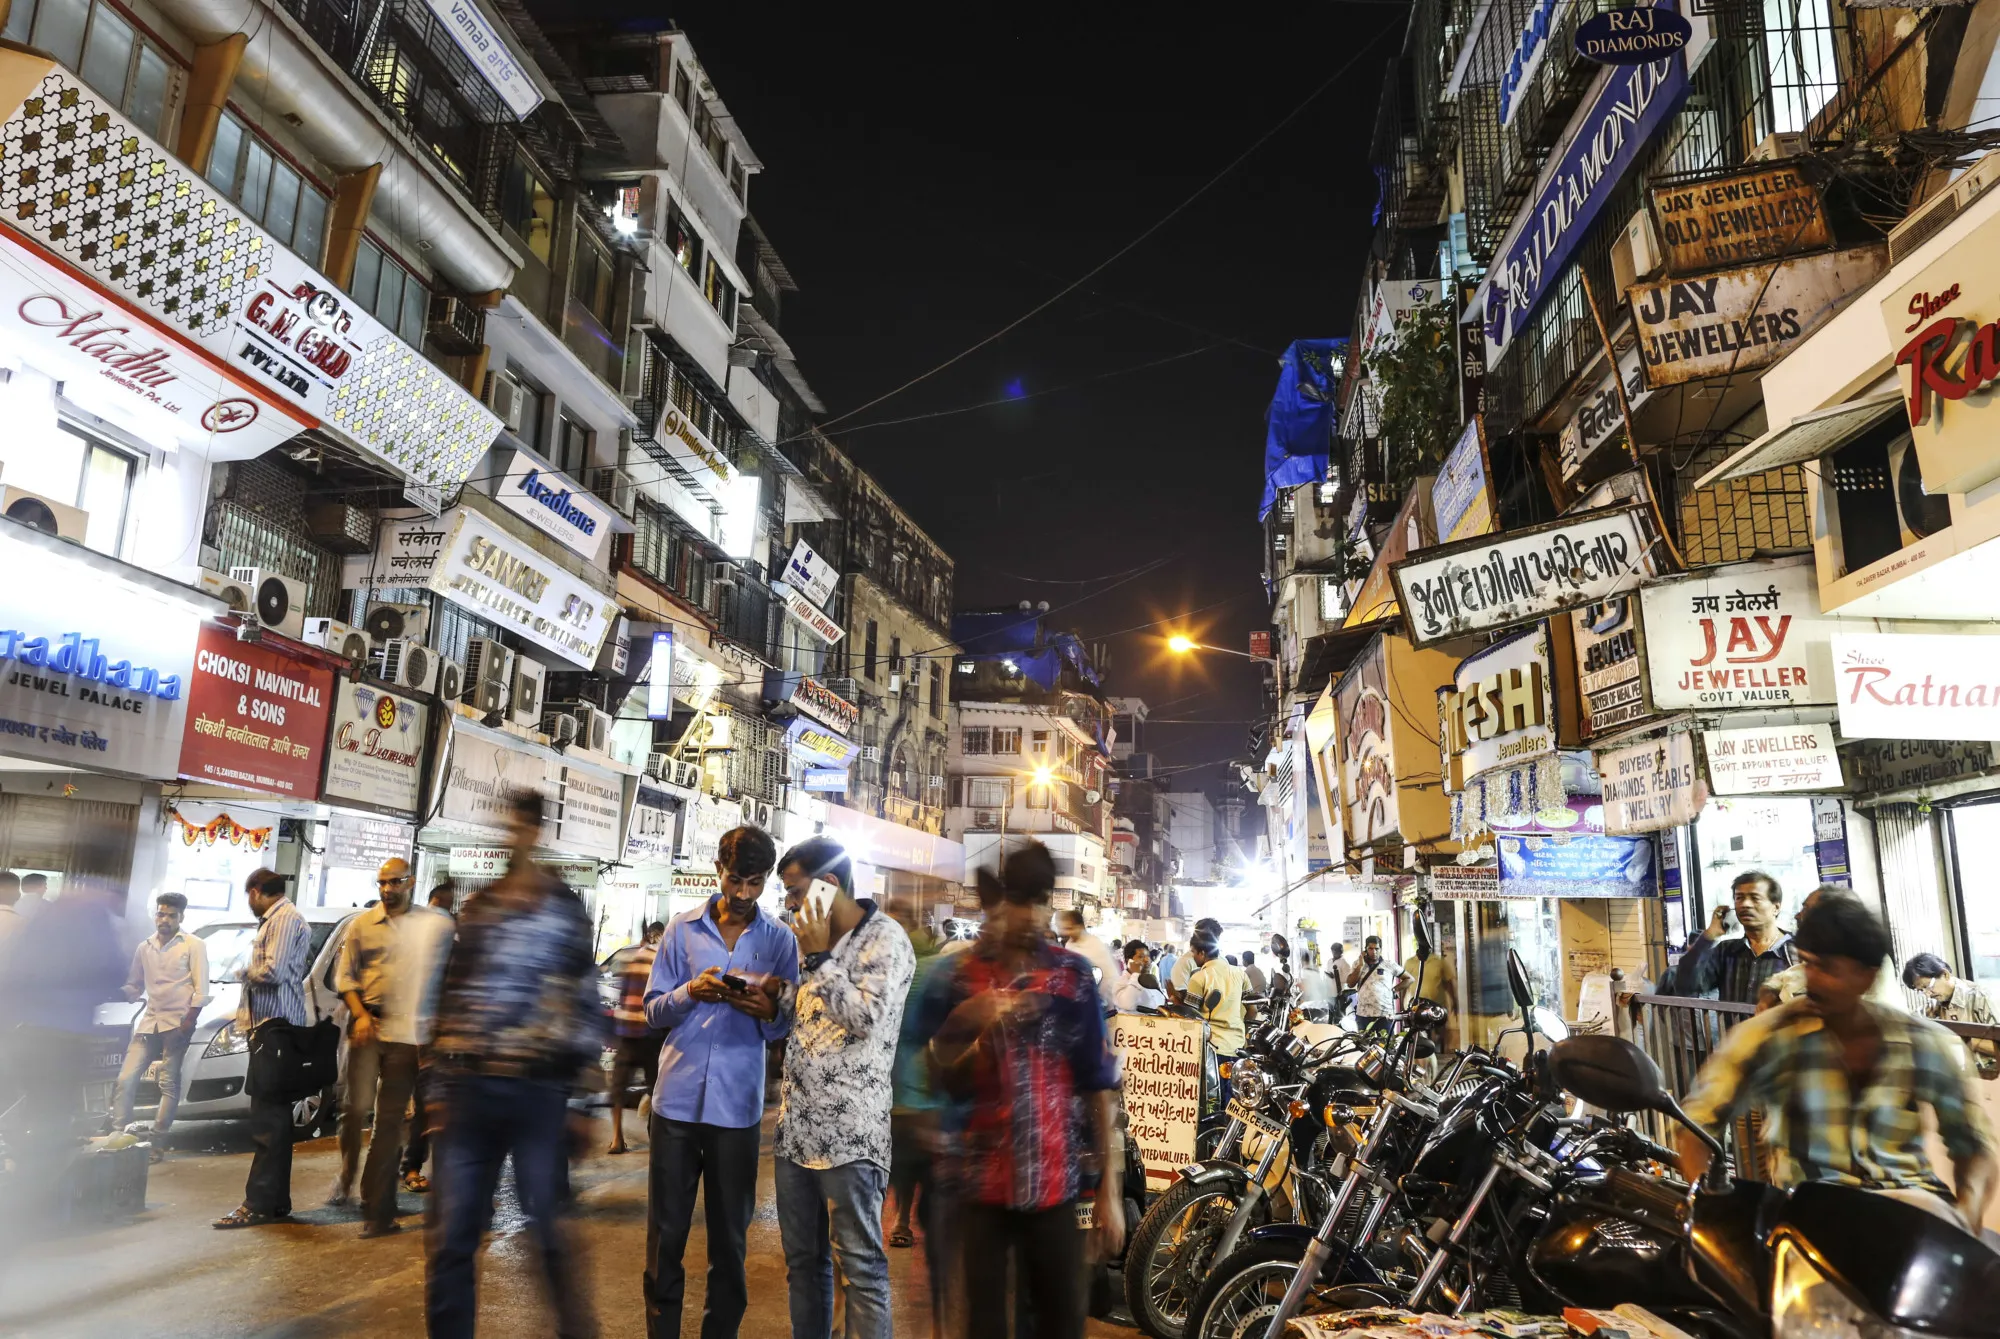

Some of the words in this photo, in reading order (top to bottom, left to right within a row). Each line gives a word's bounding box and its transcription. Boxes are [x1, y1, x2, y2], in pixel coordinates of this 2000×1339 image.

[1608, 8, 1654, 32] RAJ
[451, 2, 490, 52] vamaa
[487, 51, 513, 82] arts
[1586, 31, 1684, 55] DIAMONDS
[1661, 192, 1694, 214] JAY
[1665, 217, 1700, 247] OLD
[1706, 195, 1816, 240] JEWELLERY
[1704, 234, 1785, 263] BUYERS
[1639, 277, 1719, 325] JAY
[18, 293, 180, 389] Madhu
[1645, 308, 1802, 366] JEWELLERS
[99, 368, 144, 395] Jewellers
[1895, 317, 2000, 428] Ra
[518, 468, 597, 536] Aradhana
[398, 526, 446, 547] संकेत
[526, 507, 576, 542] JEWELLERS
[391, 550, 440, 569] ज्वेलर्स
[1692, 595, 1720, 614] जय
[1725, 584, 1781, 613] ज्वेलर्स
[1584, 628, 1636, 672] JEWELL
[1690, 614, 1792, 667] JAY
[1841, 649, 1885, 666] Shree
[197, 649, 251, 685] CHOKSI
[254, 668, 321, 708] NAVNITLAL
[1678, 667, 1809, 691] JEWELLER
[9, 672, 70, 697] JEWEL
[80, 687, 143, 714] PALACE
[1700, 691, 1734, 703] GOVT
[1742, 689, 1790, 701] VALUER
[237, 695, 247, 715] &
[251, 698, 286, 726] SONS
[194, 712, 225, 739] चोकशी
[224, 724, 270, 750] नवनीतलाल
[271, 736, 291, 756] आणि
[337, 721, 360, 753] Om
[363, 728, 422, 767] Diamond
[1714, 739, 1736, 757] JAY
[1742, 734, 1818, 754] JEWELLERS
[1618, 752, 1653, 776] BUYERS
[1742, 758, 1792, 770] APPOINTED
[1794, 754, 1829, 765] VALUER
[1651, 764, 1691, 793] PEARLS
[1817, 811, 1839, 825] NITESH
[452, 850, 482, 859] JUGRAJ
[483, 850, 511, 859] KANTIL
[483, 862, 494, 870] CO
[671, 877, 718, 888] ANUJA
[1158, 1032, 1193, 1054] મોતી
[1140, 1148, 1159, 1161] NTED
